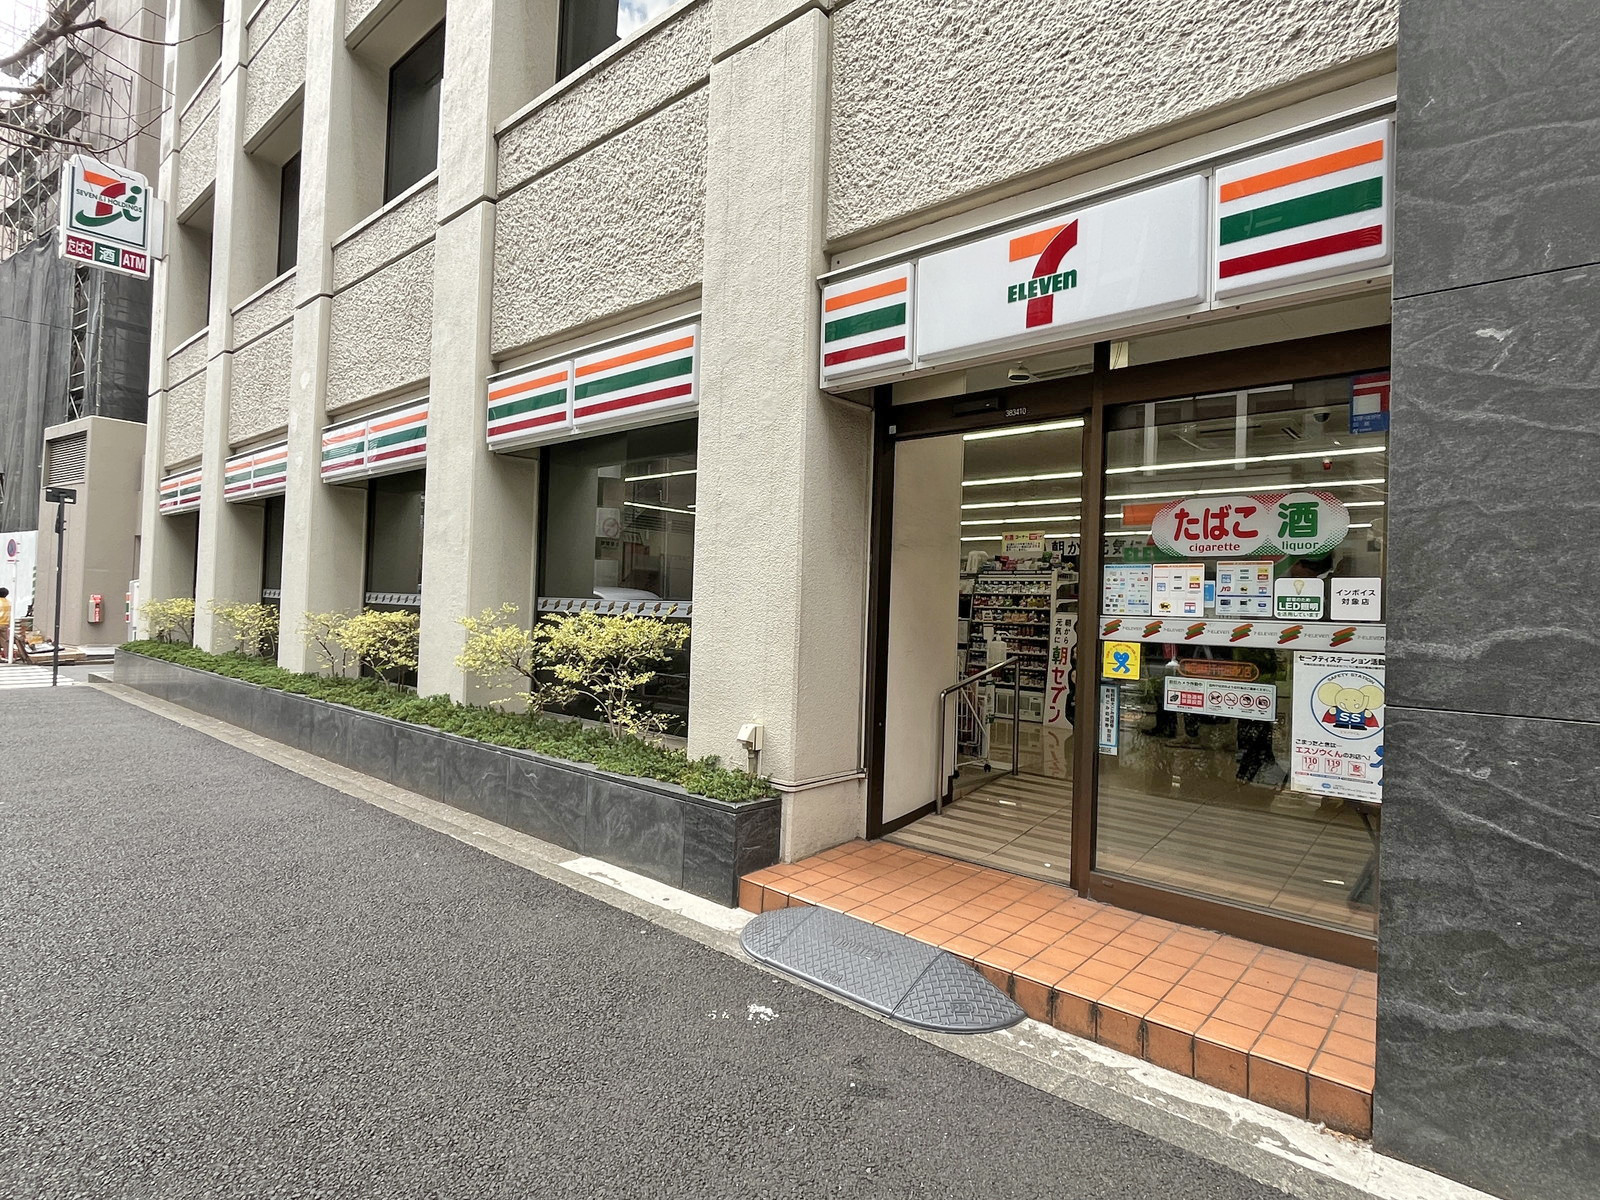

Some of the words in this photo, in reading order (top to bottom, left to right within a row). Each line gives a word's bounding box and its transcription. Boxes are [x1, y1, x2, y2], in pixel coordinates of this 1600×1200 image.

[76, 188, 98, 200] SEVEN
[108, 199, 142, 213] HOLDINGS
[67, 239, 92, 256] たばこ
[99, 246, 115, 263] 酒
[122, 254, 145, 270] ATM
[1174, 504, 1259, 541] たばこ
[1278, 502, 1319, 538] 酒
[1189, 542, 1240, 553] cigarette
[1282, 541, 1319, 551] liquor
[1279, 602, 1319, 610] LED照明
[1054, 618, 1063, 644] 元気に
[1064, 619, 1072, 644] 朝から
[1048, 646, 1068, 722] 朝セブン
[1328, 673, 1348, 681] SAFETY
[1350, 673, 1375, 684] STATION
